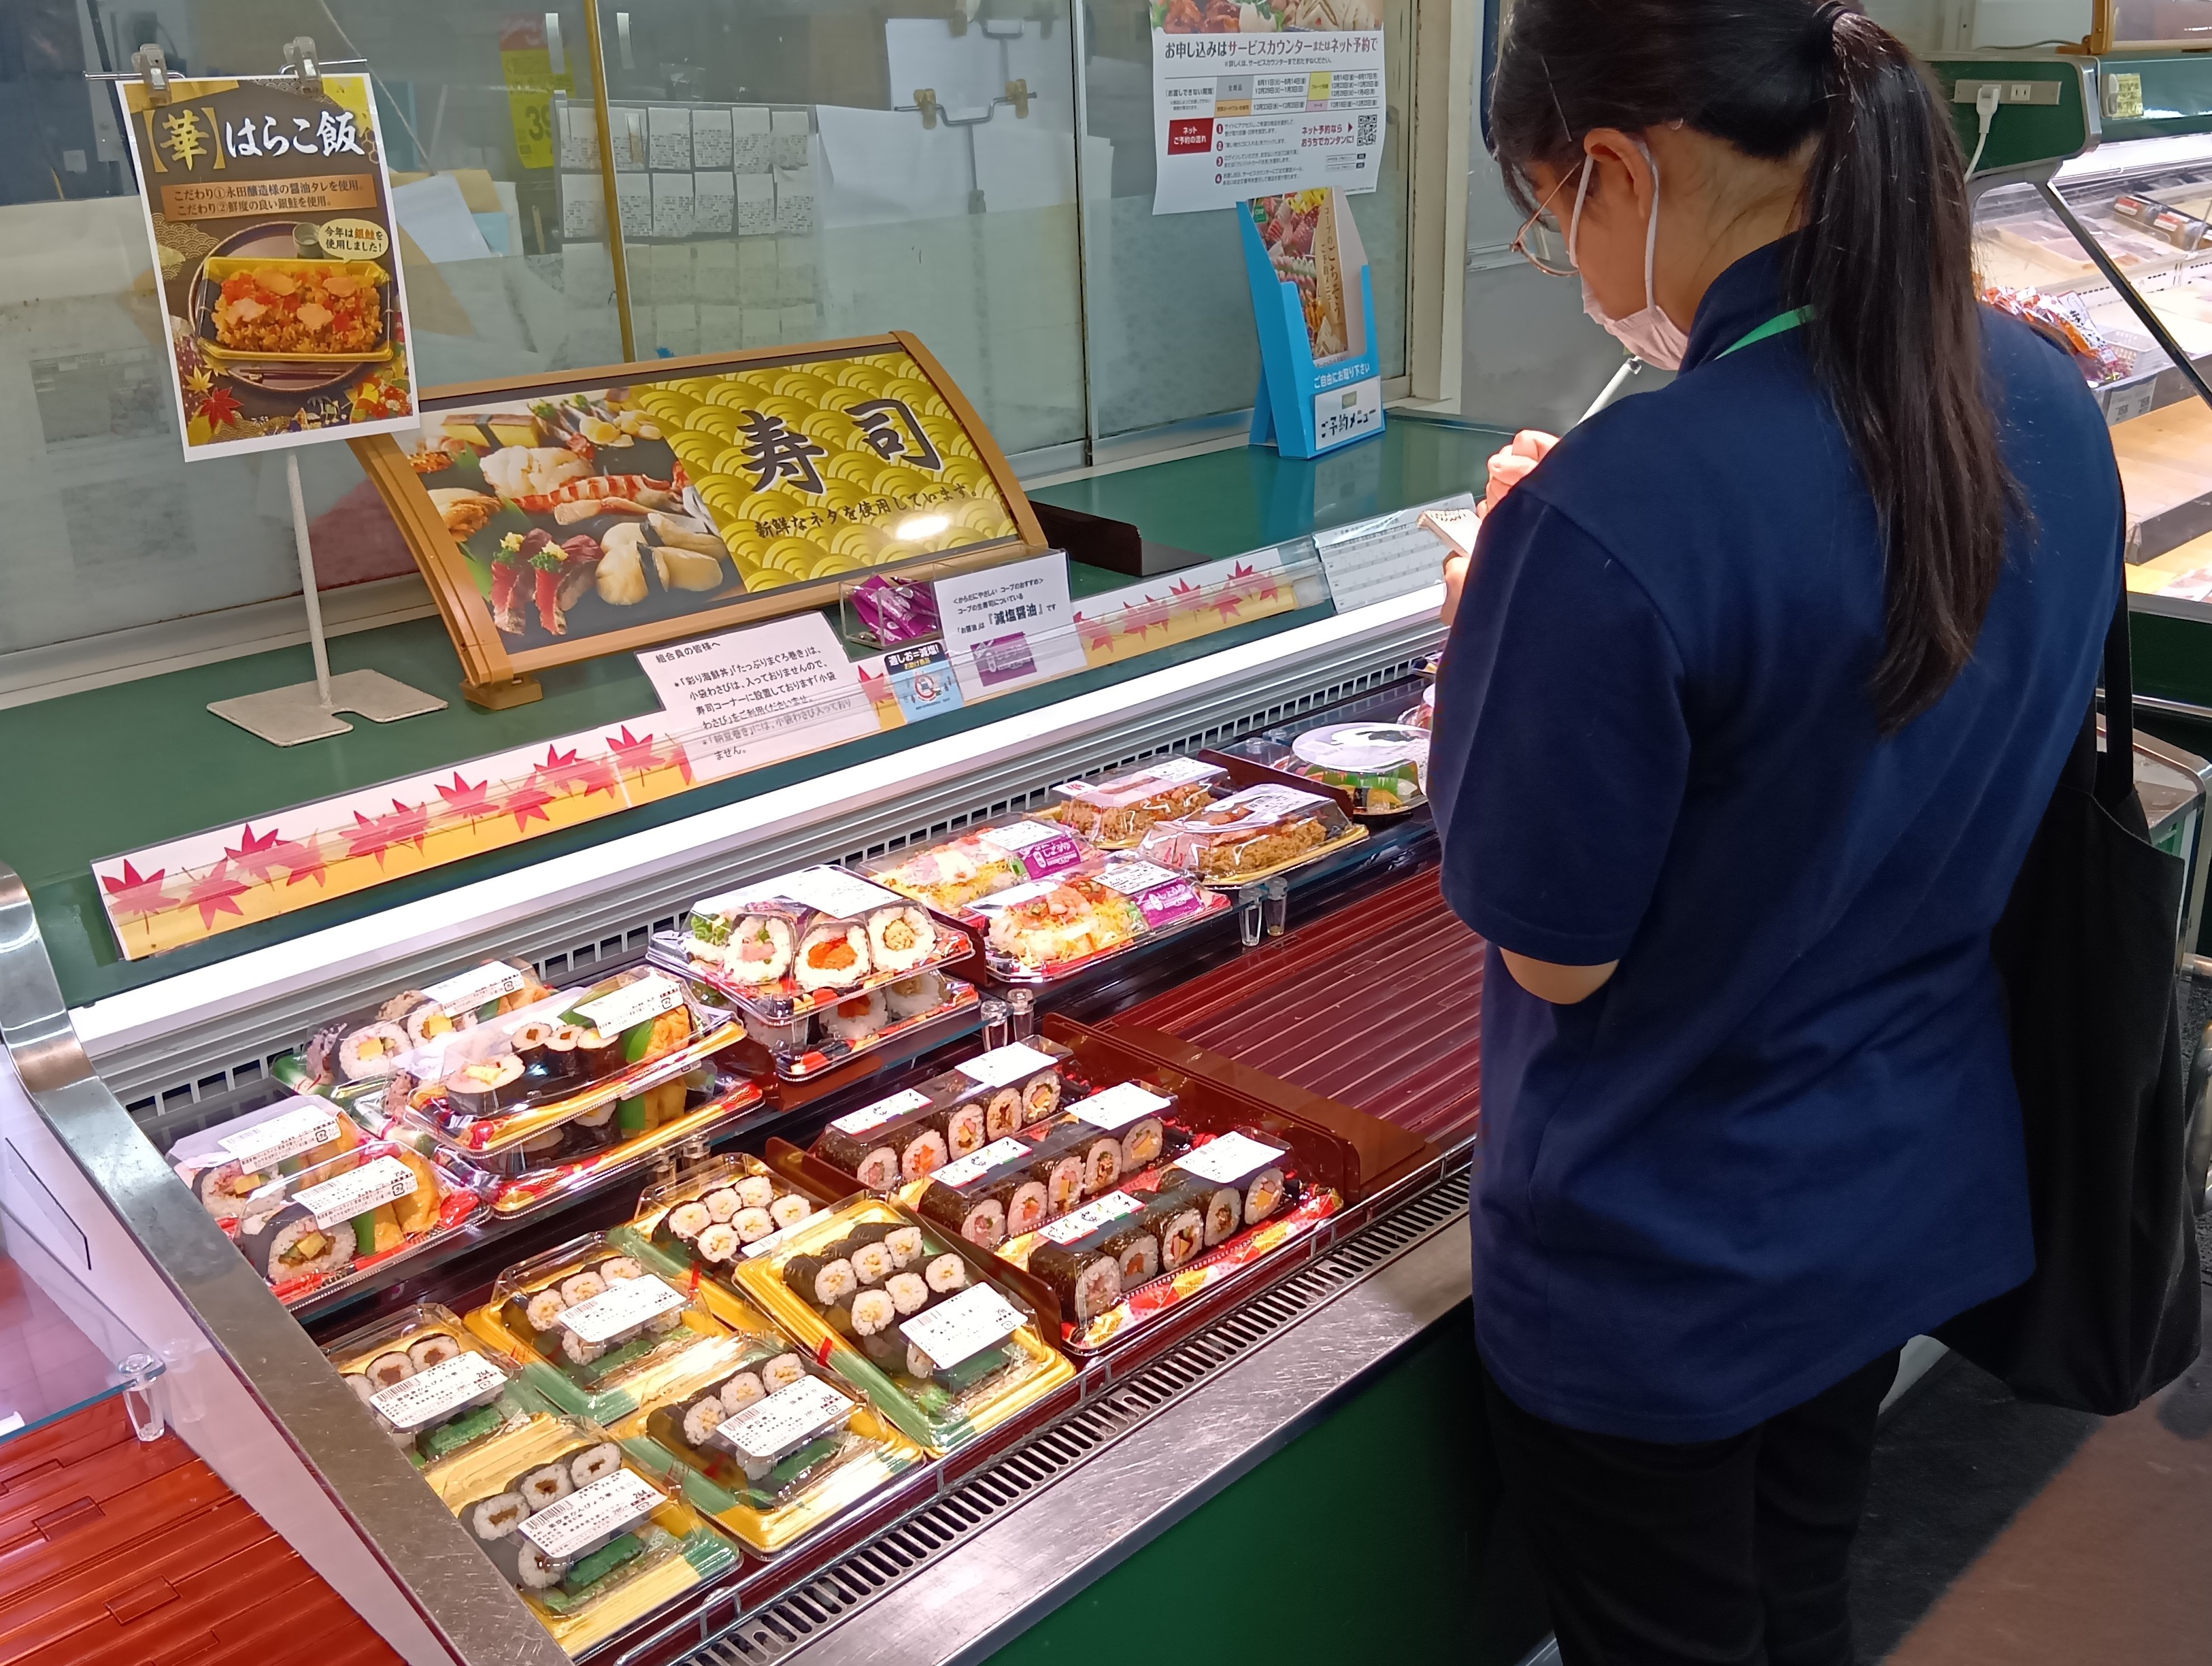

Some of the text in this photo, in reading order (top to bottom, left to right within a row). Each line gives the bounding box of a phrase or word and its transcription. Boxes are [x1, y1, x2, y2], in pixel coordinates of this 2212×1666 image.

[1164, 37, 1378, 59] お申し込みはサービスカウンターまたはネット予約で
[143, 107, 365, 173] 【華】はらこ飯
[1173, 135, 1207, 145] ご予約の流れ
[1183, 127, 1197, 135] ネット
[1302, 124, 1343, 135] ネット予約なら
[325, 225, 382, 241] 今年は銀鮭を
[1314, 363, 1371, 389] ご自由にお取り下さい
[1321, 409, 1377, 438] ご予約メニュー
[755, 483, 977, 539] 新鮮なネタを使用しています。
[957, 593, 1024, 614] コープの生寿司についている
[655, 640, 721, 663] 組合員の皆様へ
[689, 660, 828, 701] 小袋わさびは、入っておりませんので、
[702, 695, 815, 730] わさび」をご利用くださいませ。
[714, 748, 747, 761] ません。
